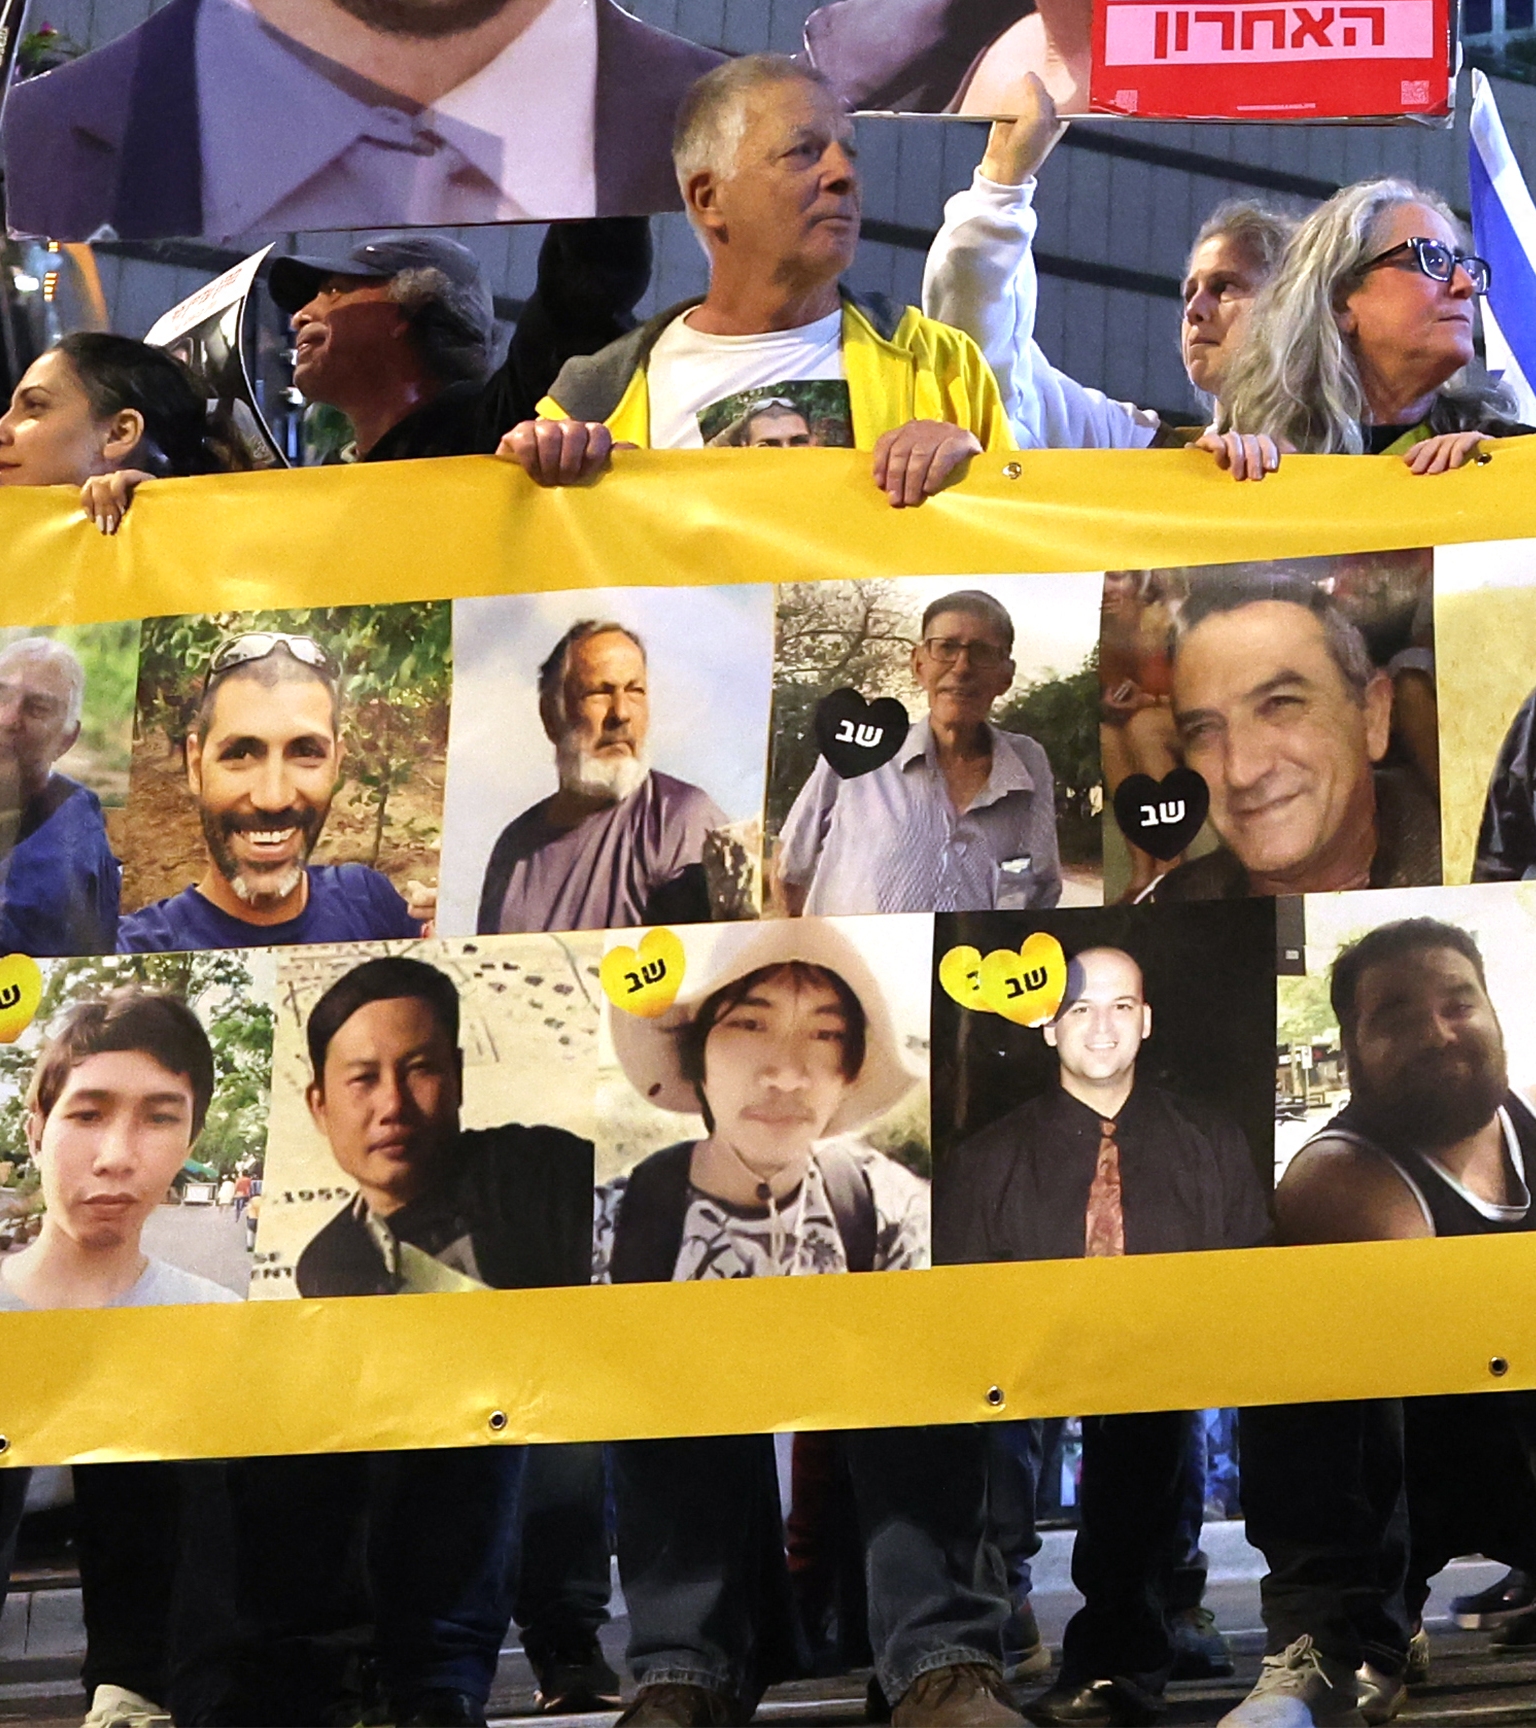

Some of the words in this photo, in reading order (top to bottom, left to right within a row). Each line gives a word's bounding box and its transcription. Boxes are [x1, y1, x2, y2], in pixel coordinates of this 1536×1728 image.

[1154, 7, 1385, 59] האחרון
[834, 719, 884, 748] שב
[1139, 800, 1186, 827] שב
[624, 958, 667, 994] שב
[1004, 967, 1048, 1000] שב
